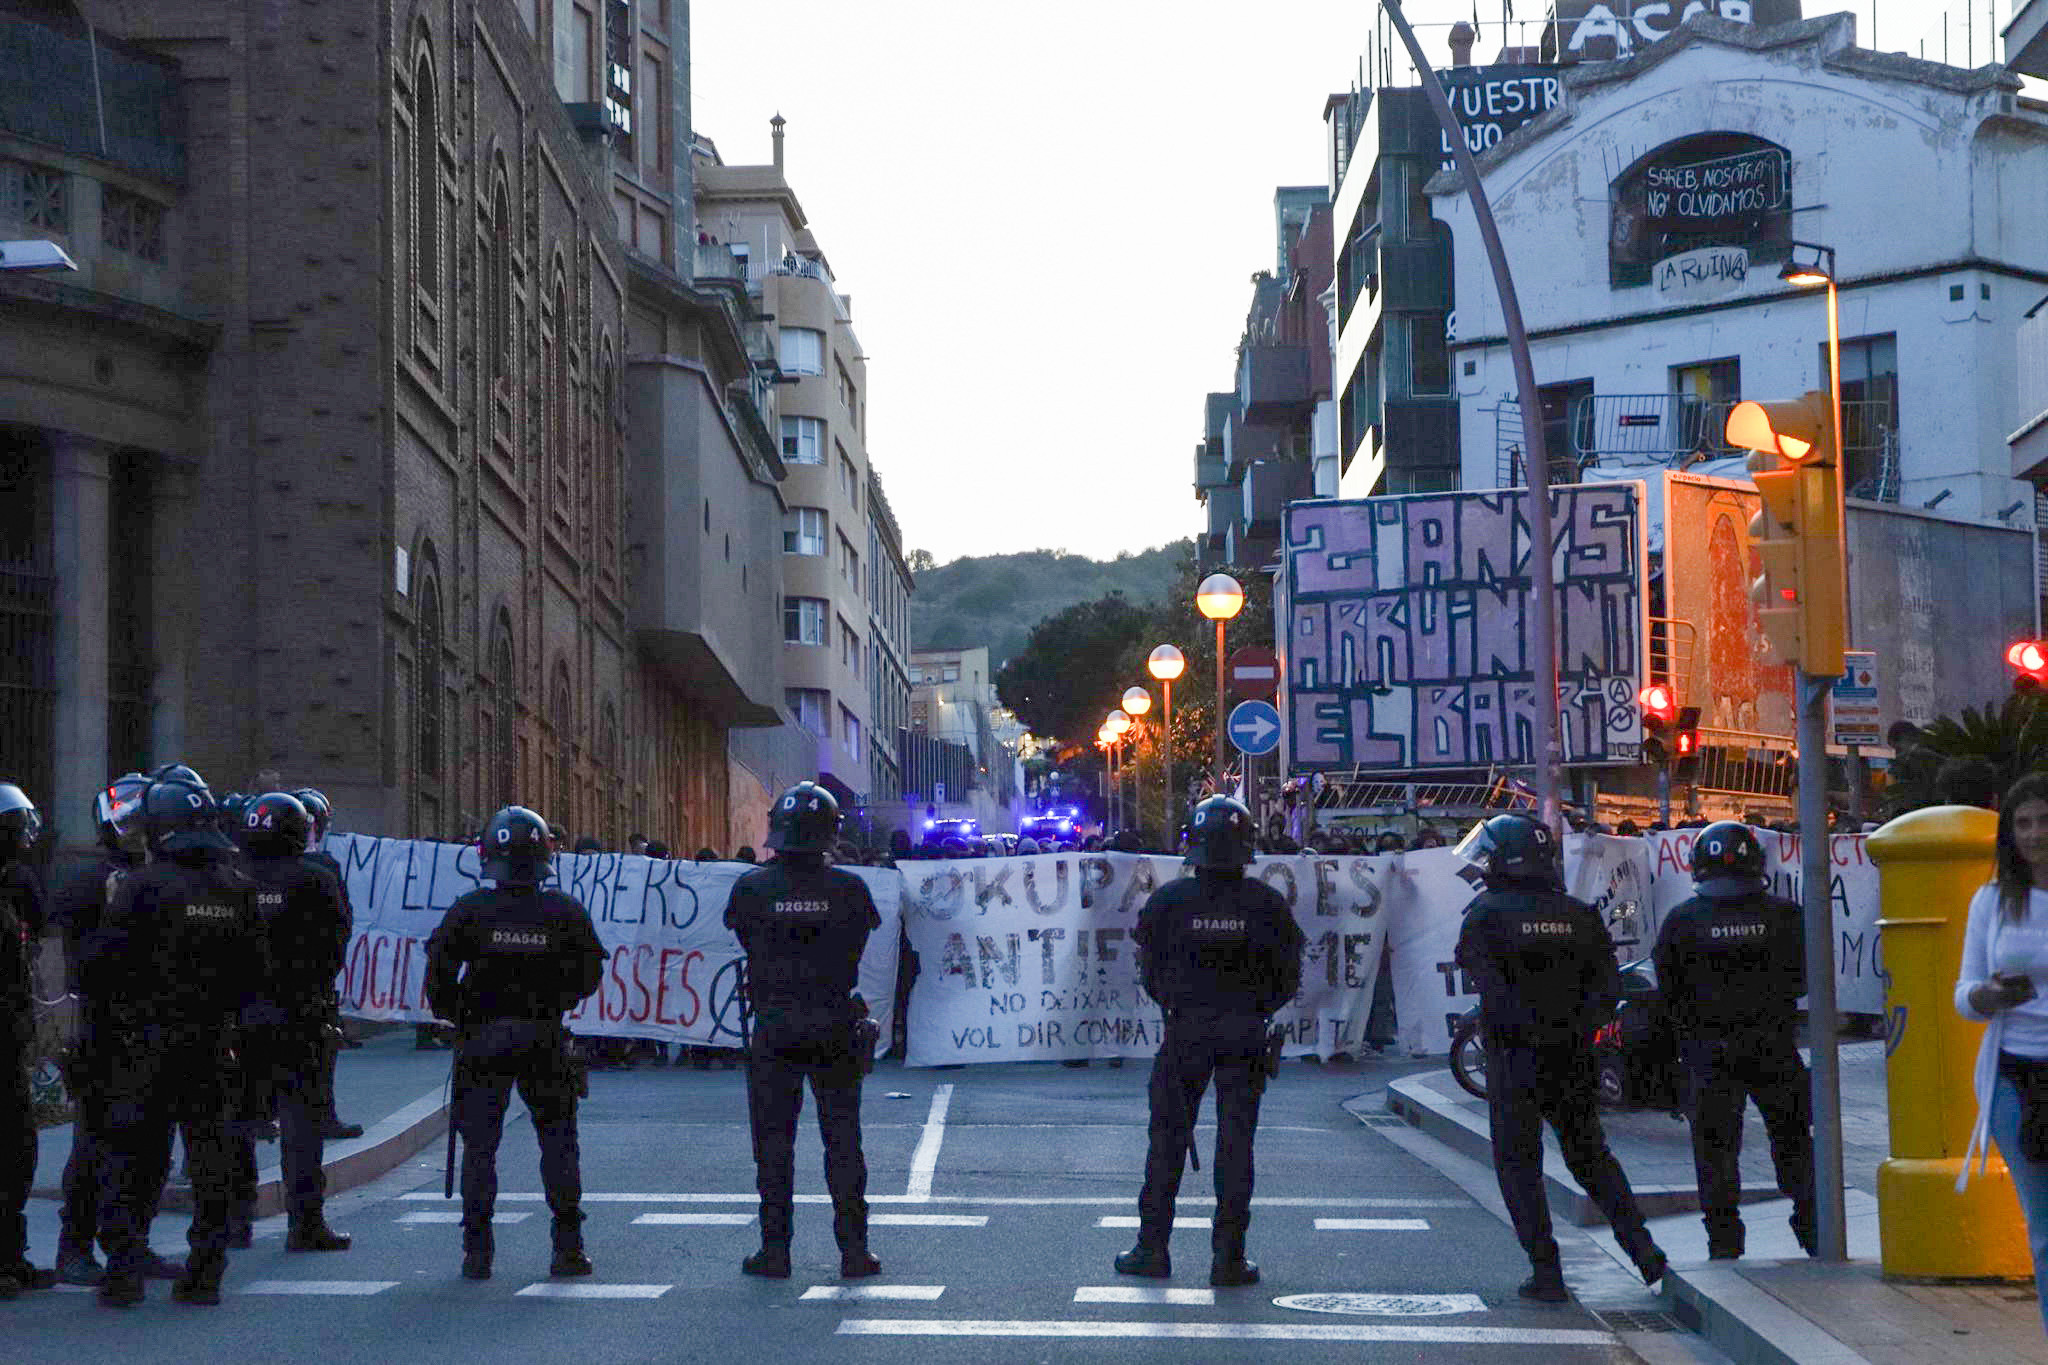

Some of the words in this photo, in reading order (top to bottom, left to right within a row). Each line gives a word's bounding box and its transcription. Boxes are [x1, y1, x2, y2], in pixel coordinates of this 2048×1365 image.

[1678, 183, 1766, 217] OLVIDAMOS
[1660, 260, 1676, 292] LA
[1292, 688, 1410, 768] EL
[783, 796, 796, 810] D
[808, 798, 818, 810] 4
[248, 813, 258, 827] D
[262, 814, 272, 829] 4
[1195, 811, 1206, 825] D
[1229, 812, 1238, 824] 4
[498, 828, 511, 843] D
[530, 828, 539, 841] 4
[1535, 830, 1546, 844] D
[1708, 841, 1722, 856] D
[1737, 841, 1747, 856] 4
[989, 993, 1026, 1016] NO
[951, 1026, 1001, 1049] VOL
